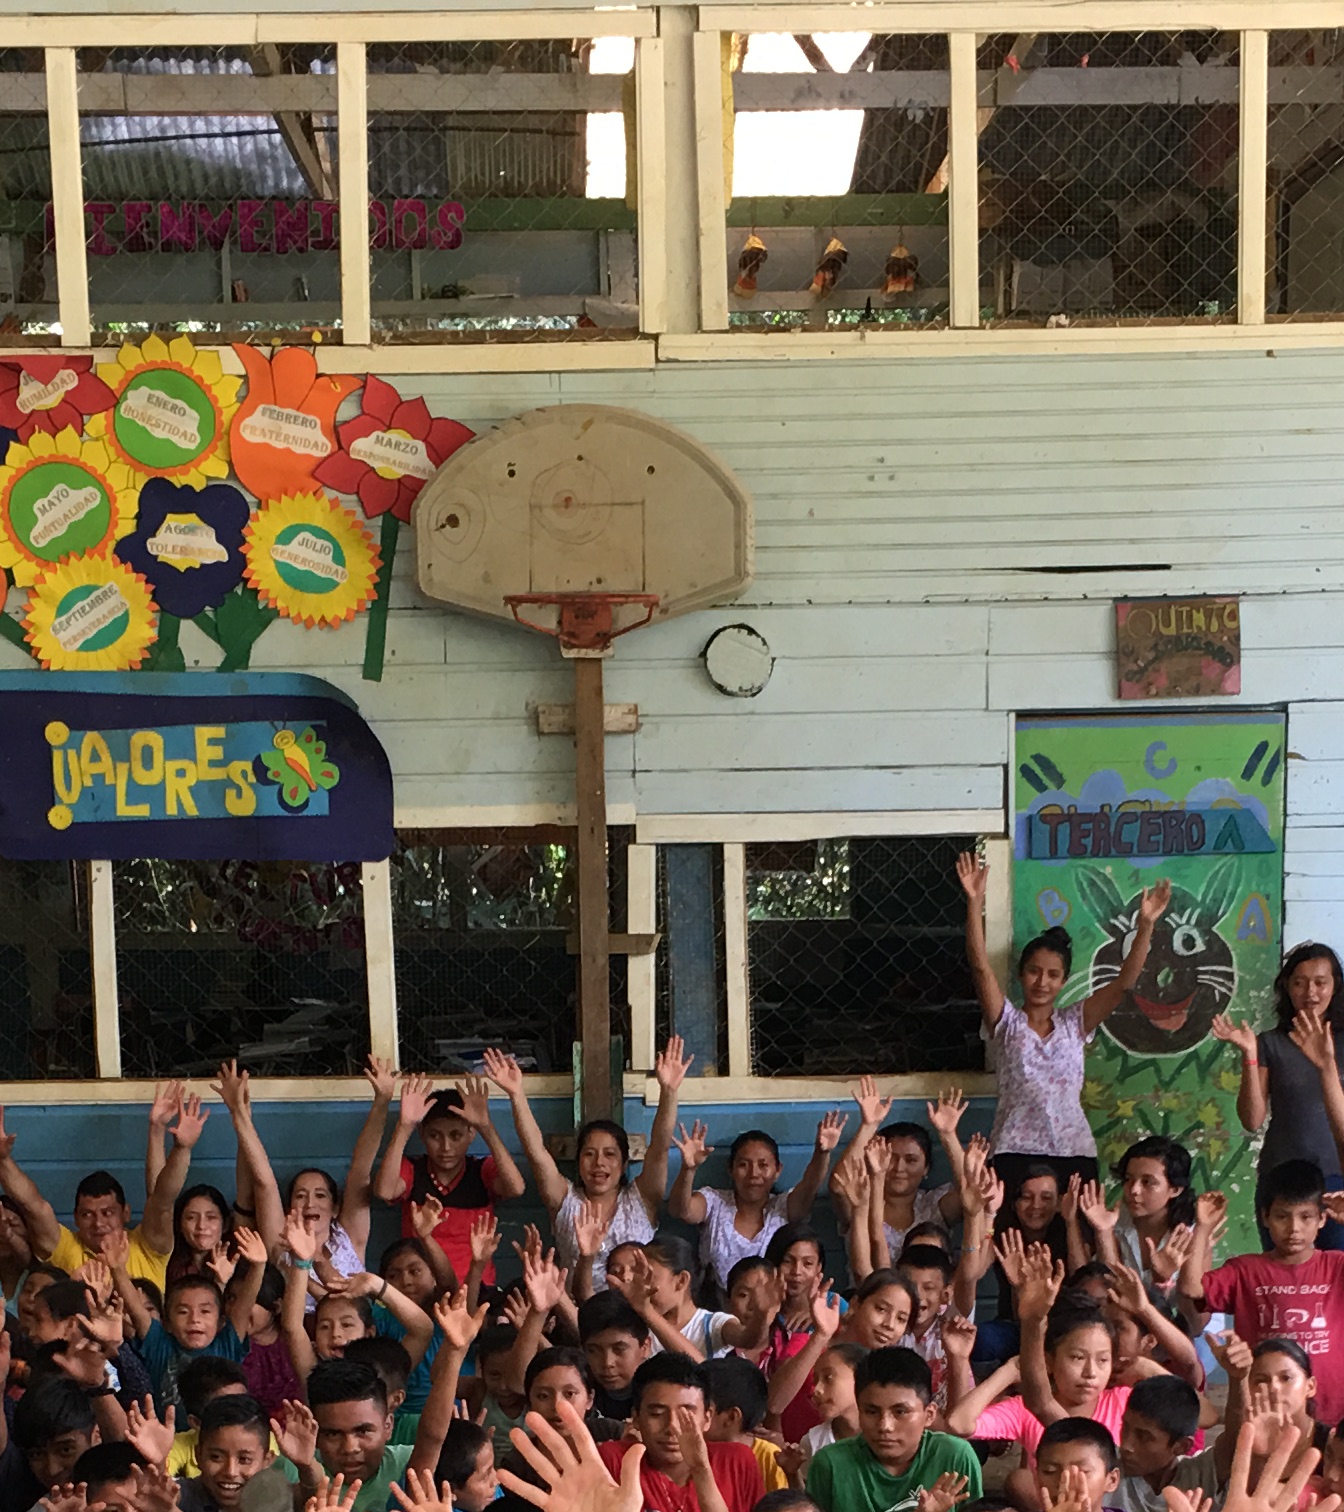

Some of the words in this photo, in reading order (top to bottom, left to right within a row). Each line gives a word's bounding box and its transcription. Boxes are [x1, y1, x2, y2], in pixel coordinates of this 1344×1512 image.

[45, 200, 466, 256] IENVENIDOS
[18, 371, 76, 411] HUMILDAD
[146, 393, 187, 418] ENERO
[122, 404, 198, 445] HONESTIDAD
[261, 406, 318, 430] FEBRERO
[242, 423, 330, 455] FRATERNIDAD
[374, 434, 419, 456] MARZO
[32, 491, 99, 545] PUNTUALIDAD
[37, 487, 70, 518] MAYO
[298, 535, 332, 557] JULIO
[272, 547, 348, 580] GENEROSIDAD
[51, 584, 118, 636] SEPTIEMBRE
[1127, 603, 1239, 639] QUINTO
[1039, 810, 1206, 857] TERCERO
[1255, 1285, 1296, 1296] STAND
